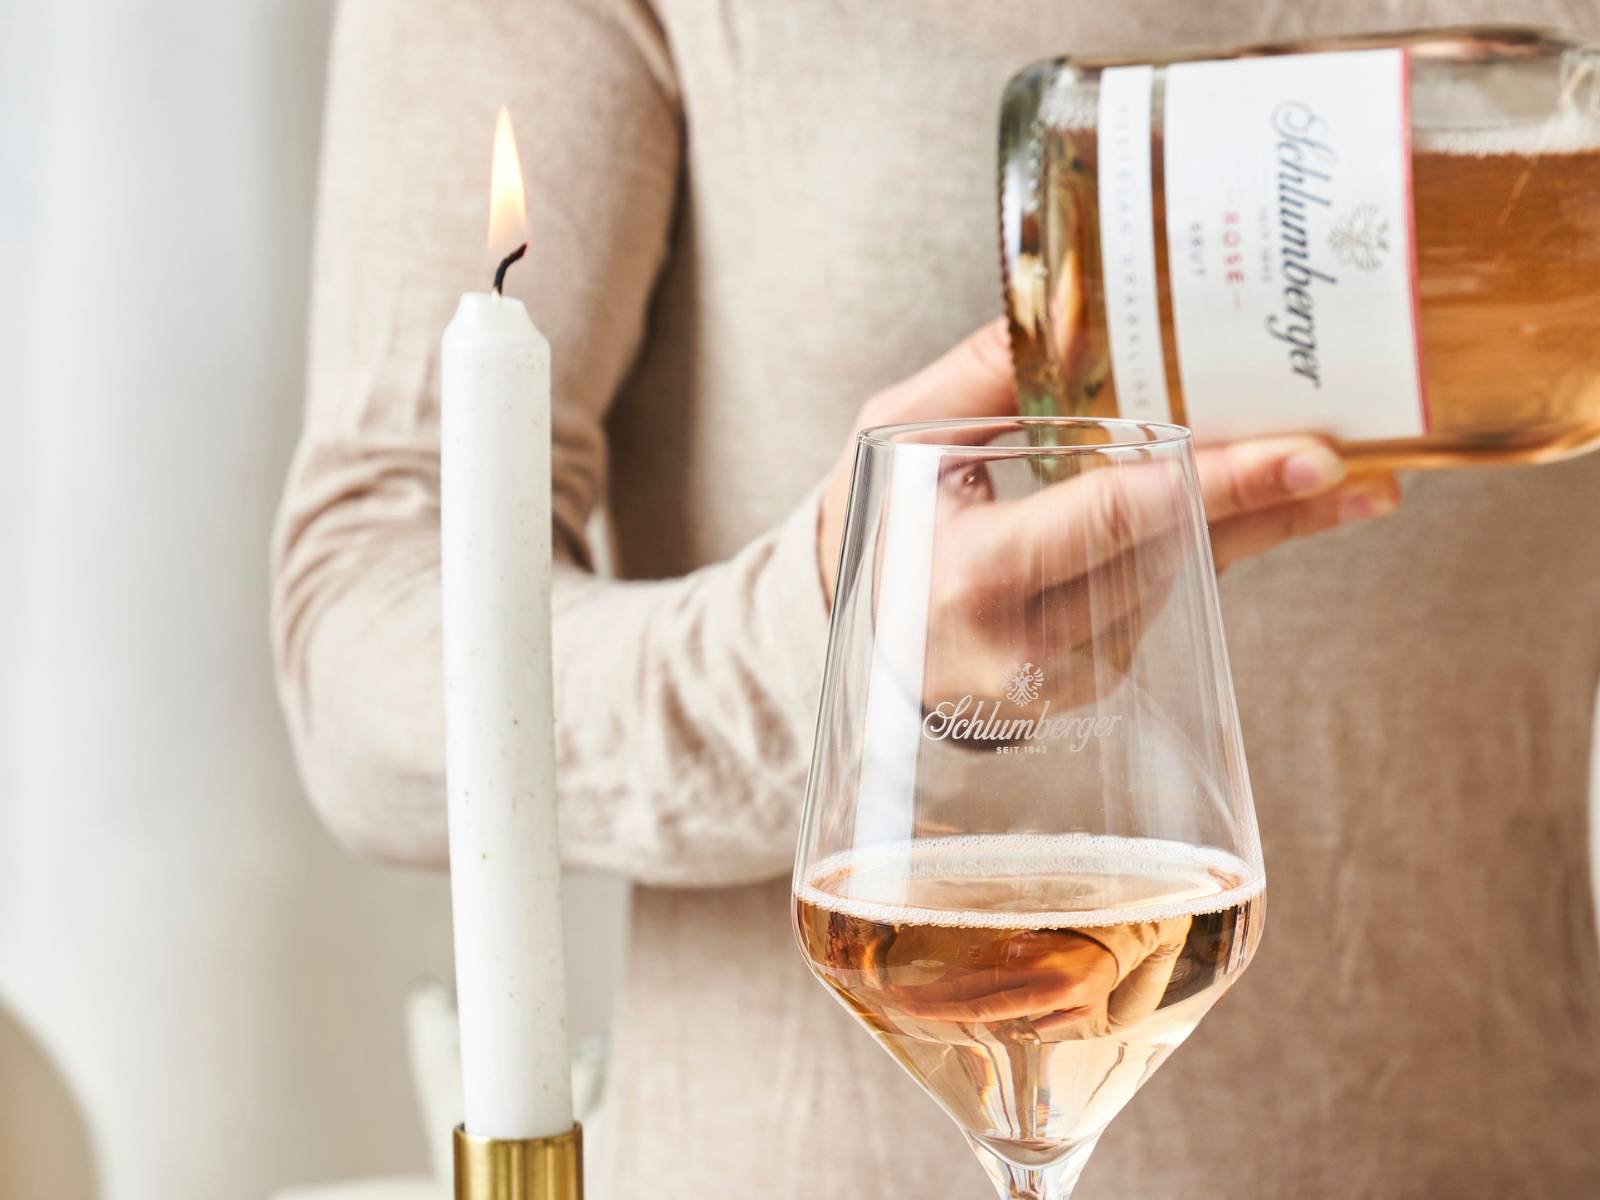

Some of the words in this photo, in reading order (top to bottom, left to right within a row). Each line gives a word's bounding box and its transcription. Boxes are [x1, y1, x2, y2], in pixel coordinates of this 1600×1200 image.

[1266, 101, 1337, 389] Schlumberger
[922, 694, 1122, 752] Schlumberger
[996, 746, 1020, 754] SEIT
[1024, 746, 1047, 754] 1842
